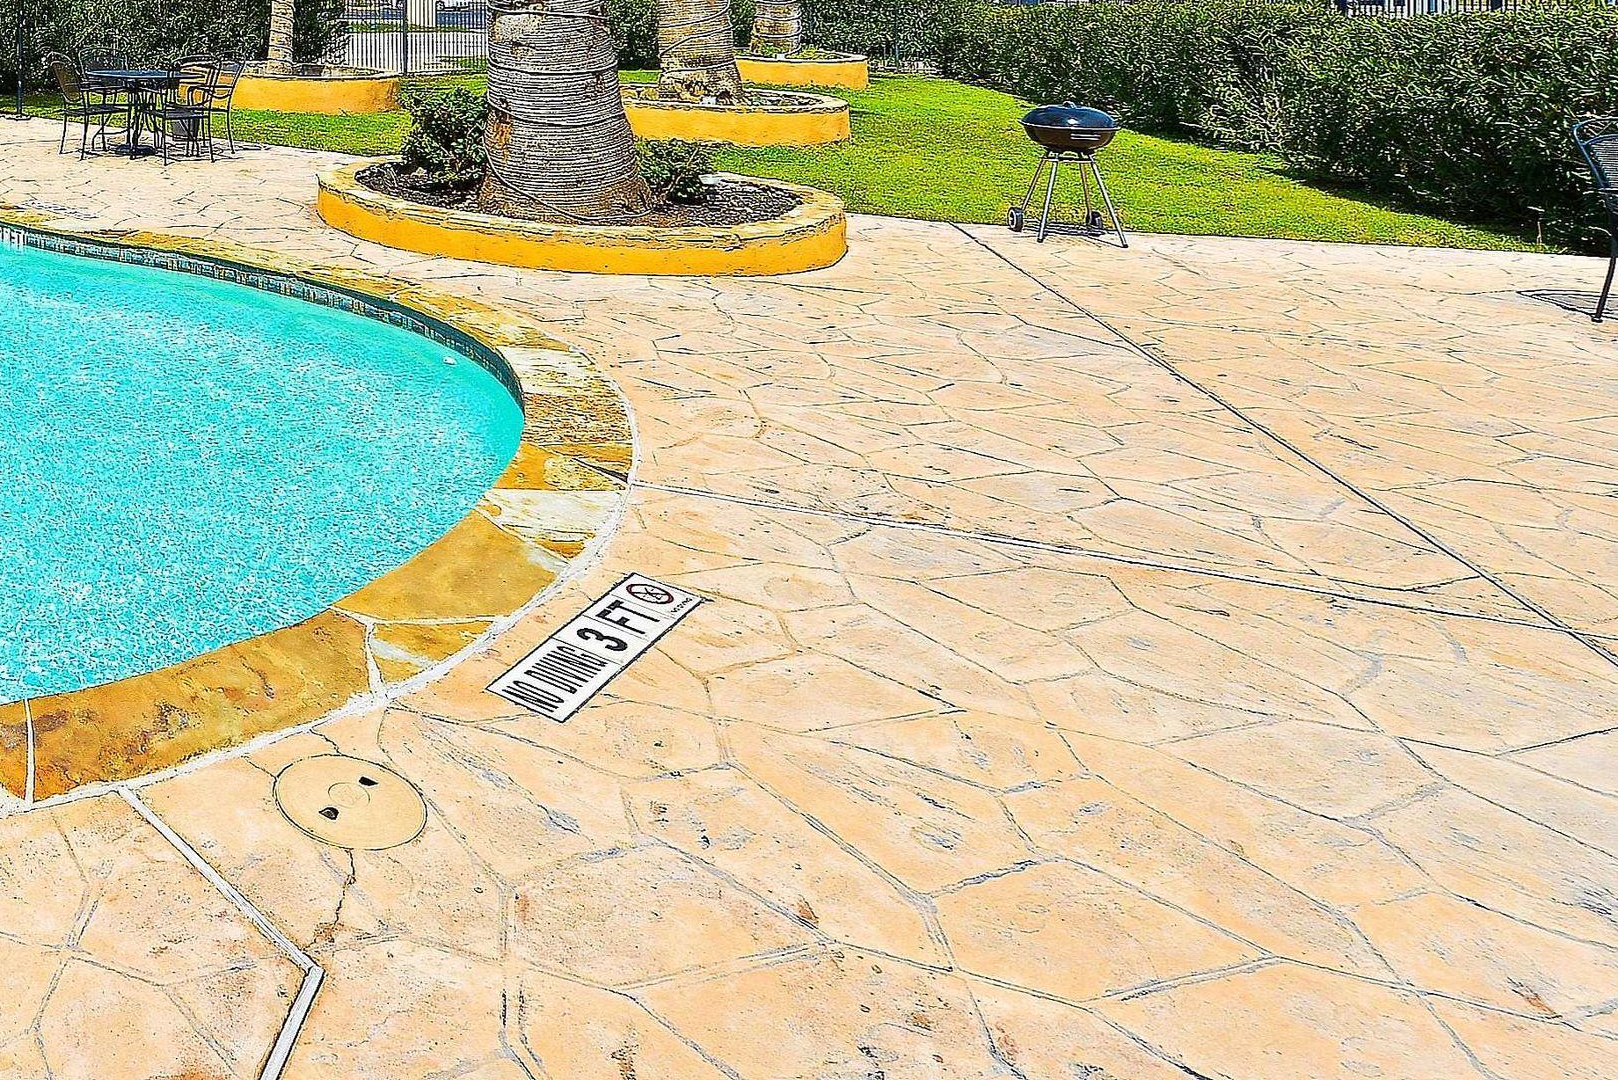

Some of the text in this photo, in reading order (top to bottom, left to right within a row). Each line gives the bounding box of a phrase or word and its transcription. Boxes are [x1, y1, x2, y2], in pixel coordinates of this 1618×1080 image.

[595, 600, 661, 635] FT
[576, 627, 629, 652] 3
[524, 645, 609, 695] DIVING
[501, 680, 565, 713] NO
